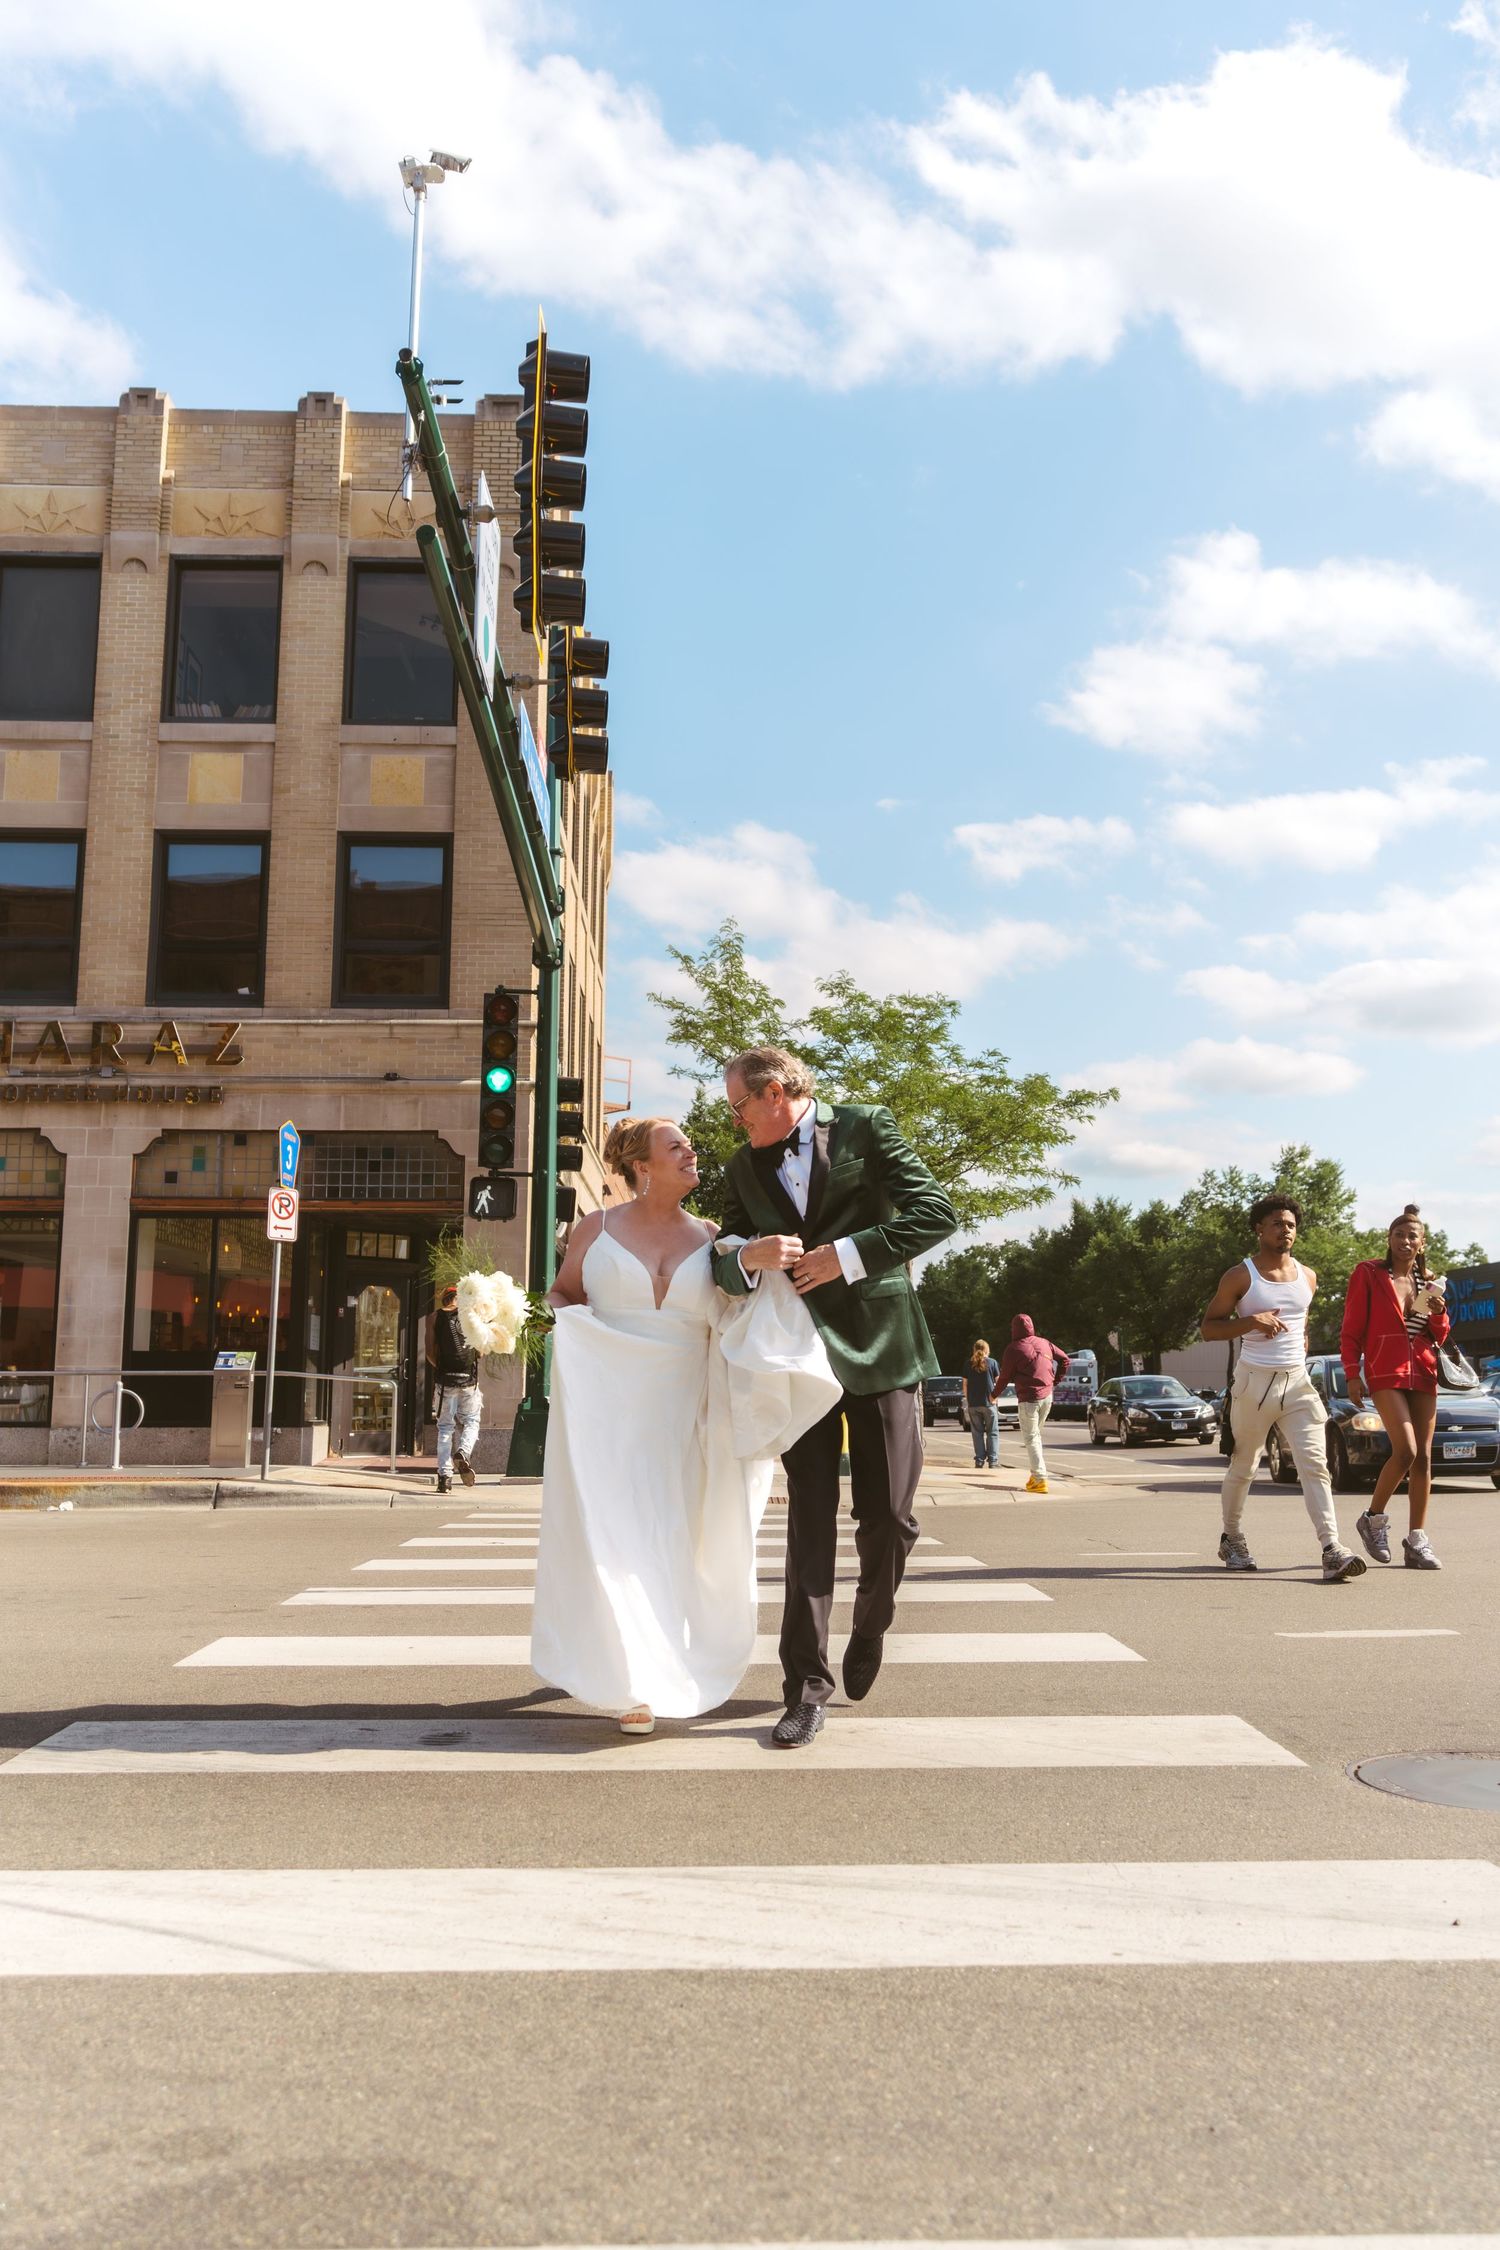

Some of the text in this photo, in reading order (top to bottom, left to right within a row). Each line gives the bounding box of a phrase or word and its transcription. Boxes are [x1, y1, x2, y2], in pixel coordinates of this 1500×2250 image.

[113, 1084, 224, 1105] HOUSE
[285, 1144, 293, 1171] 3
[1460, 1299, 1496, 1321] DOWN
